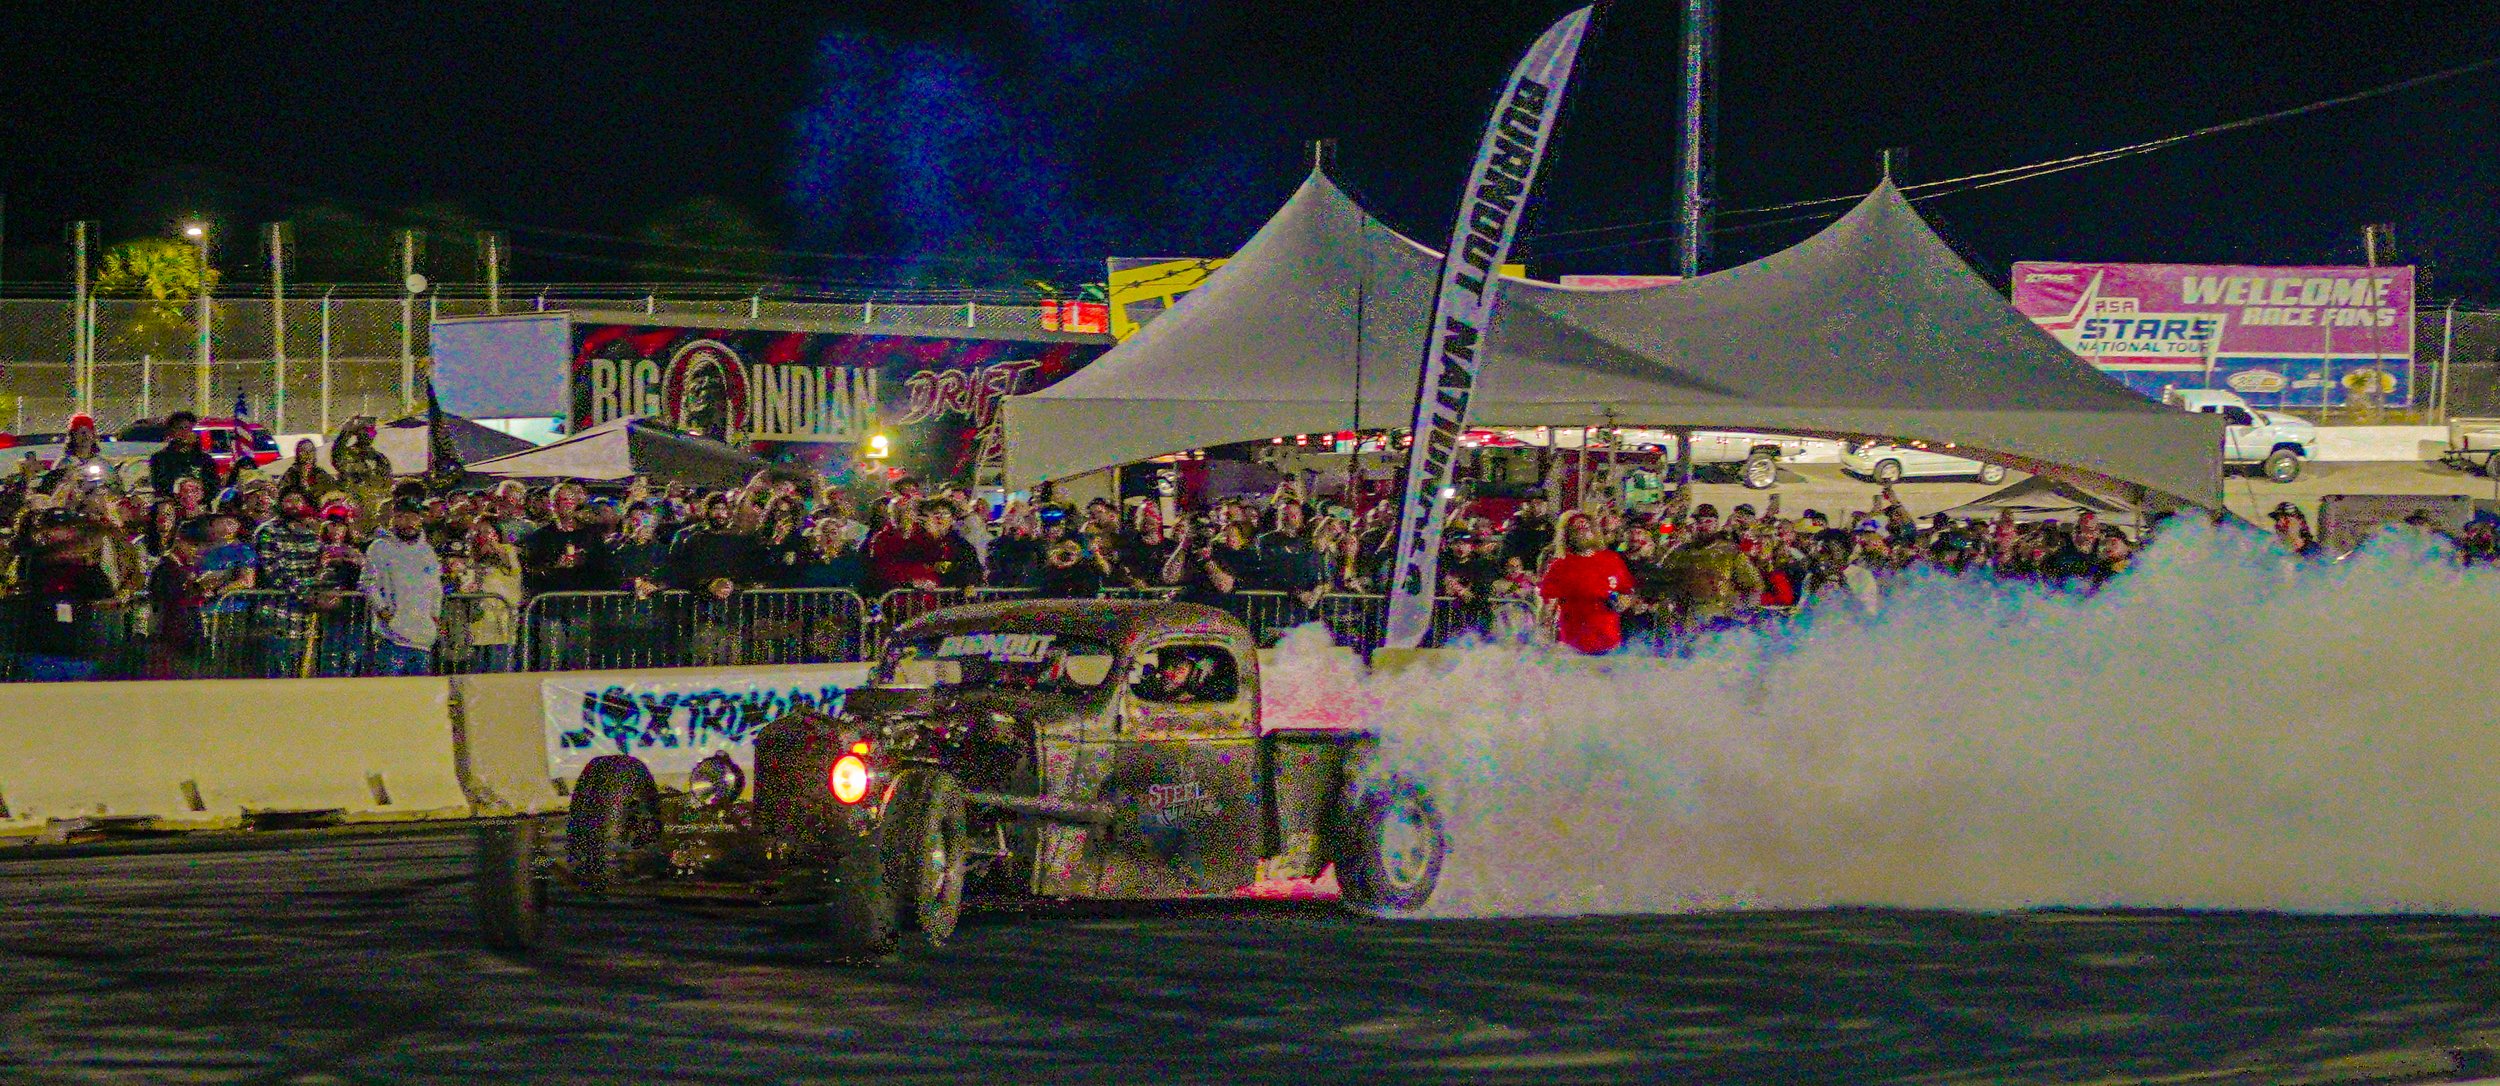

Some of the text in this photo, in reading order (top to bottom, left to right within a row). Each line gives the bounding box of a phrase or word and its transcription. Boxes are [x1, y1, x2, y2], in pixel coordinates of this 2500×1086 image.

[1456, 75, 1549, 307] BURNOUT
[2182, 276, 2393, 306] WELCOME
[2081, 318, 2217, 340] STARS
[2241, 307, 2397, 327] RACE FANS
[2077, 341, 2209, 353] NATIONAL TOUR
[592, 358, 878, 433] BIG INDIAN
[898, 359, 1043, 428] DRIFT
